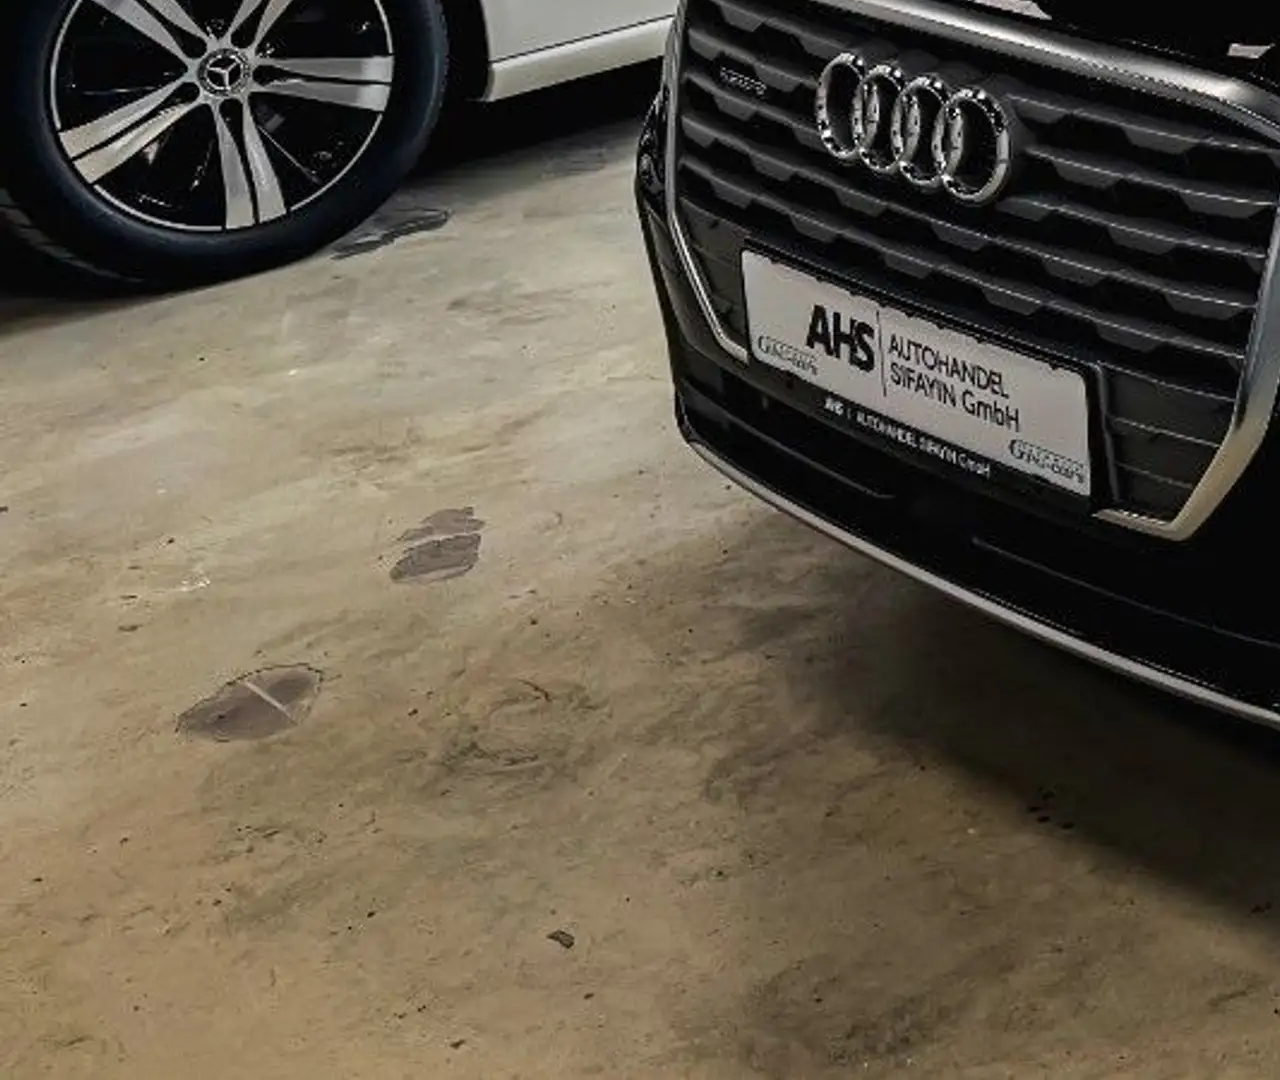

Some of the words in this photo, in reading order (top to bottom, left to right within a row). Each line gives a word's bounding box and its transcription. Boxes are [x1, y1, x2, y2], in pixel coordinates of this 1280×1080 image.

[806, 304, 875, 373] AHS
[888, 333, 1010, 399] AUTOHANDEL
[889, 362, 956, 408] SIFAYIN
[962, 389, 1021, 432] GmbH
